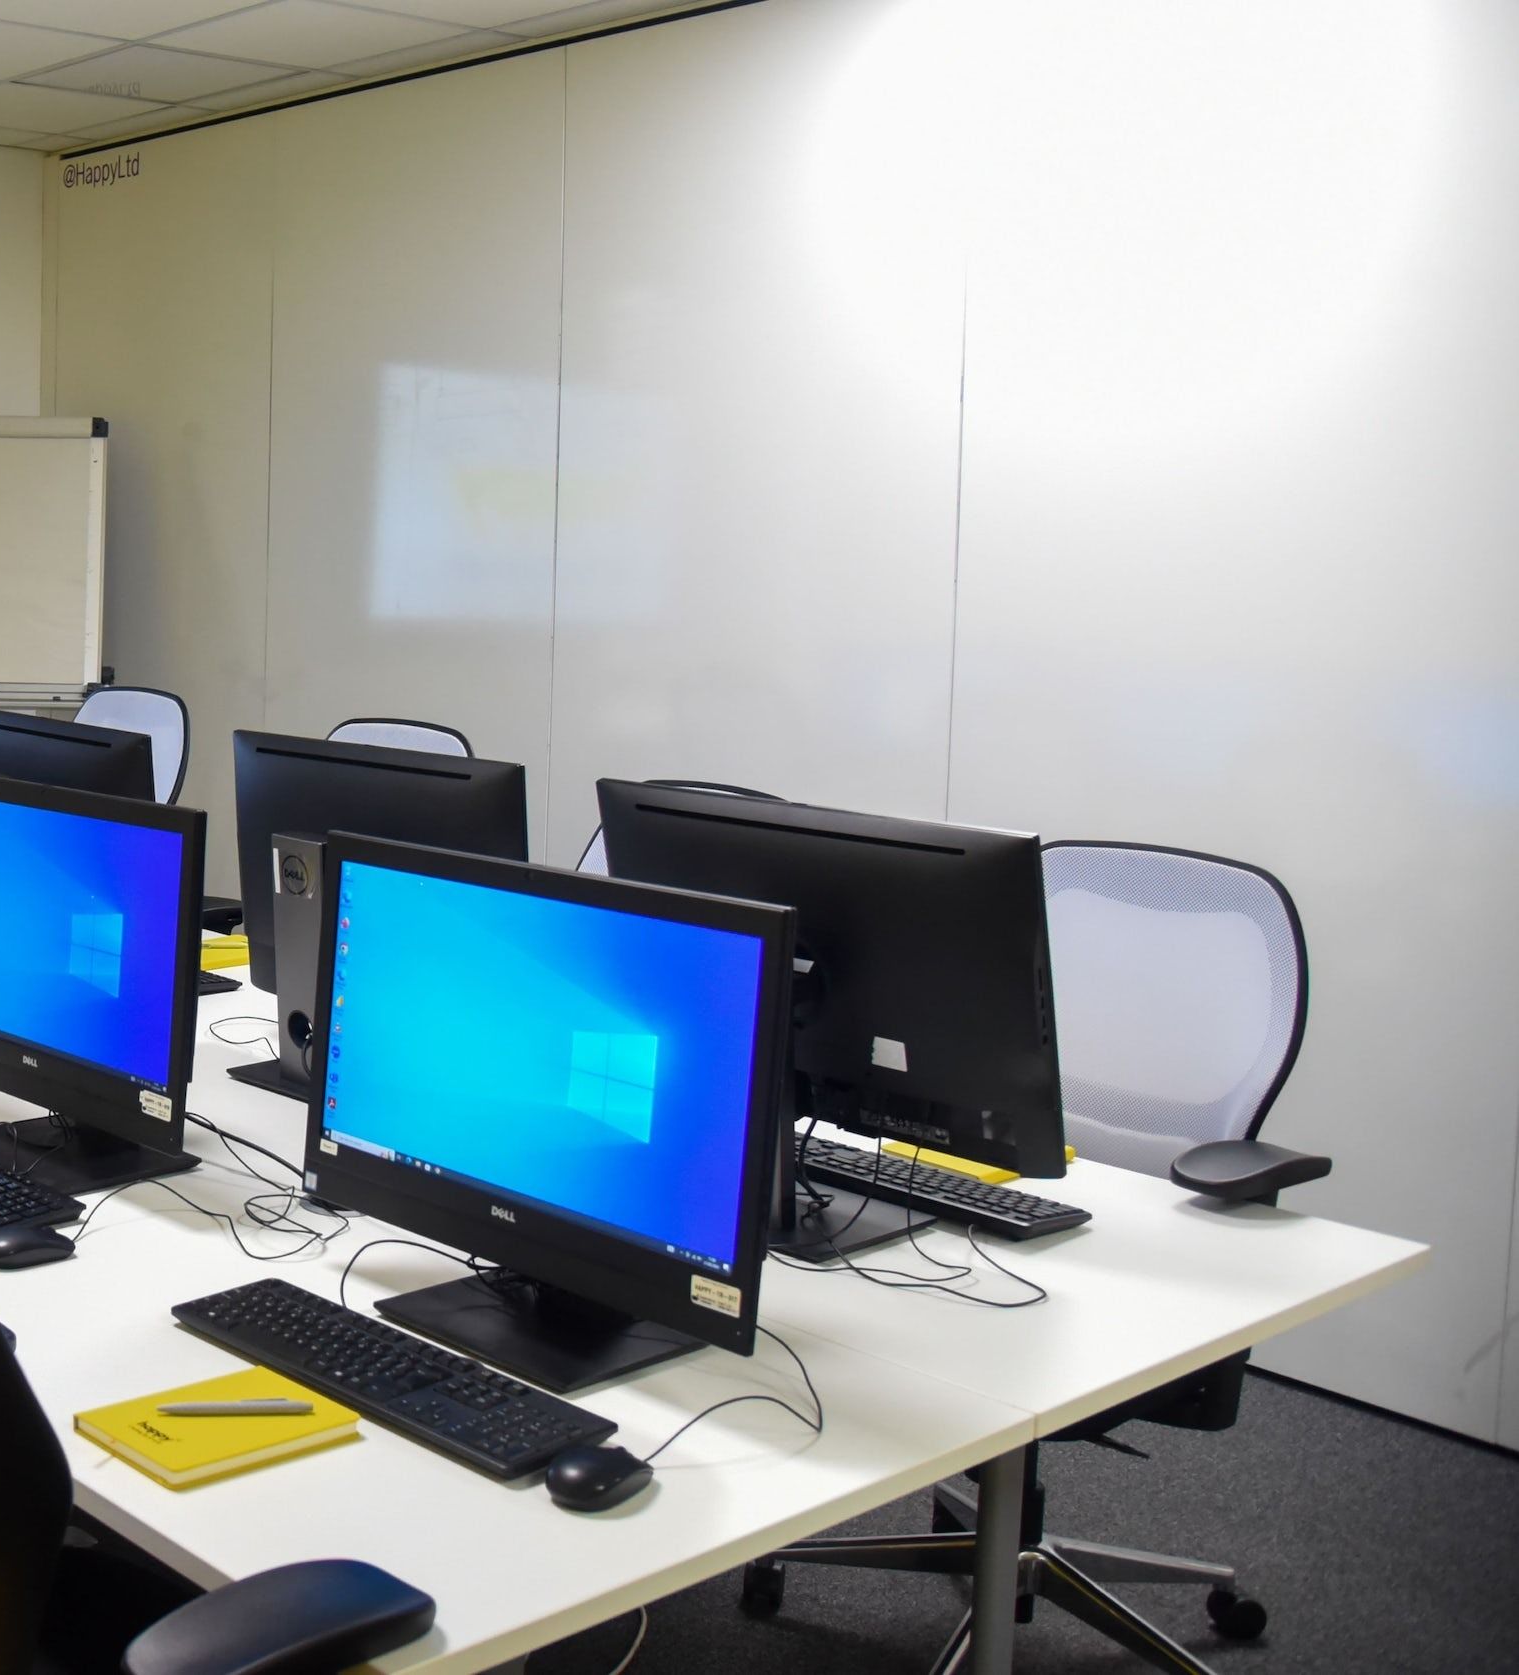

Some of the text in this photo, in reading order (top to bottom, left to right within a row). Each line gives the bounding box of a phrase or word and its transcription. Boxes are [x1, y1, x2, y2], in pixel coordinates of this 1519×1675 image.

[63, 152, 140, 188] @HappyLtd
[284, 868, 305, 881] DELL
[22, 1055, 38, 1068] DELL
[491, 1205, 516, 1223] DELL
[137, 1421, 170, 1440] happy
